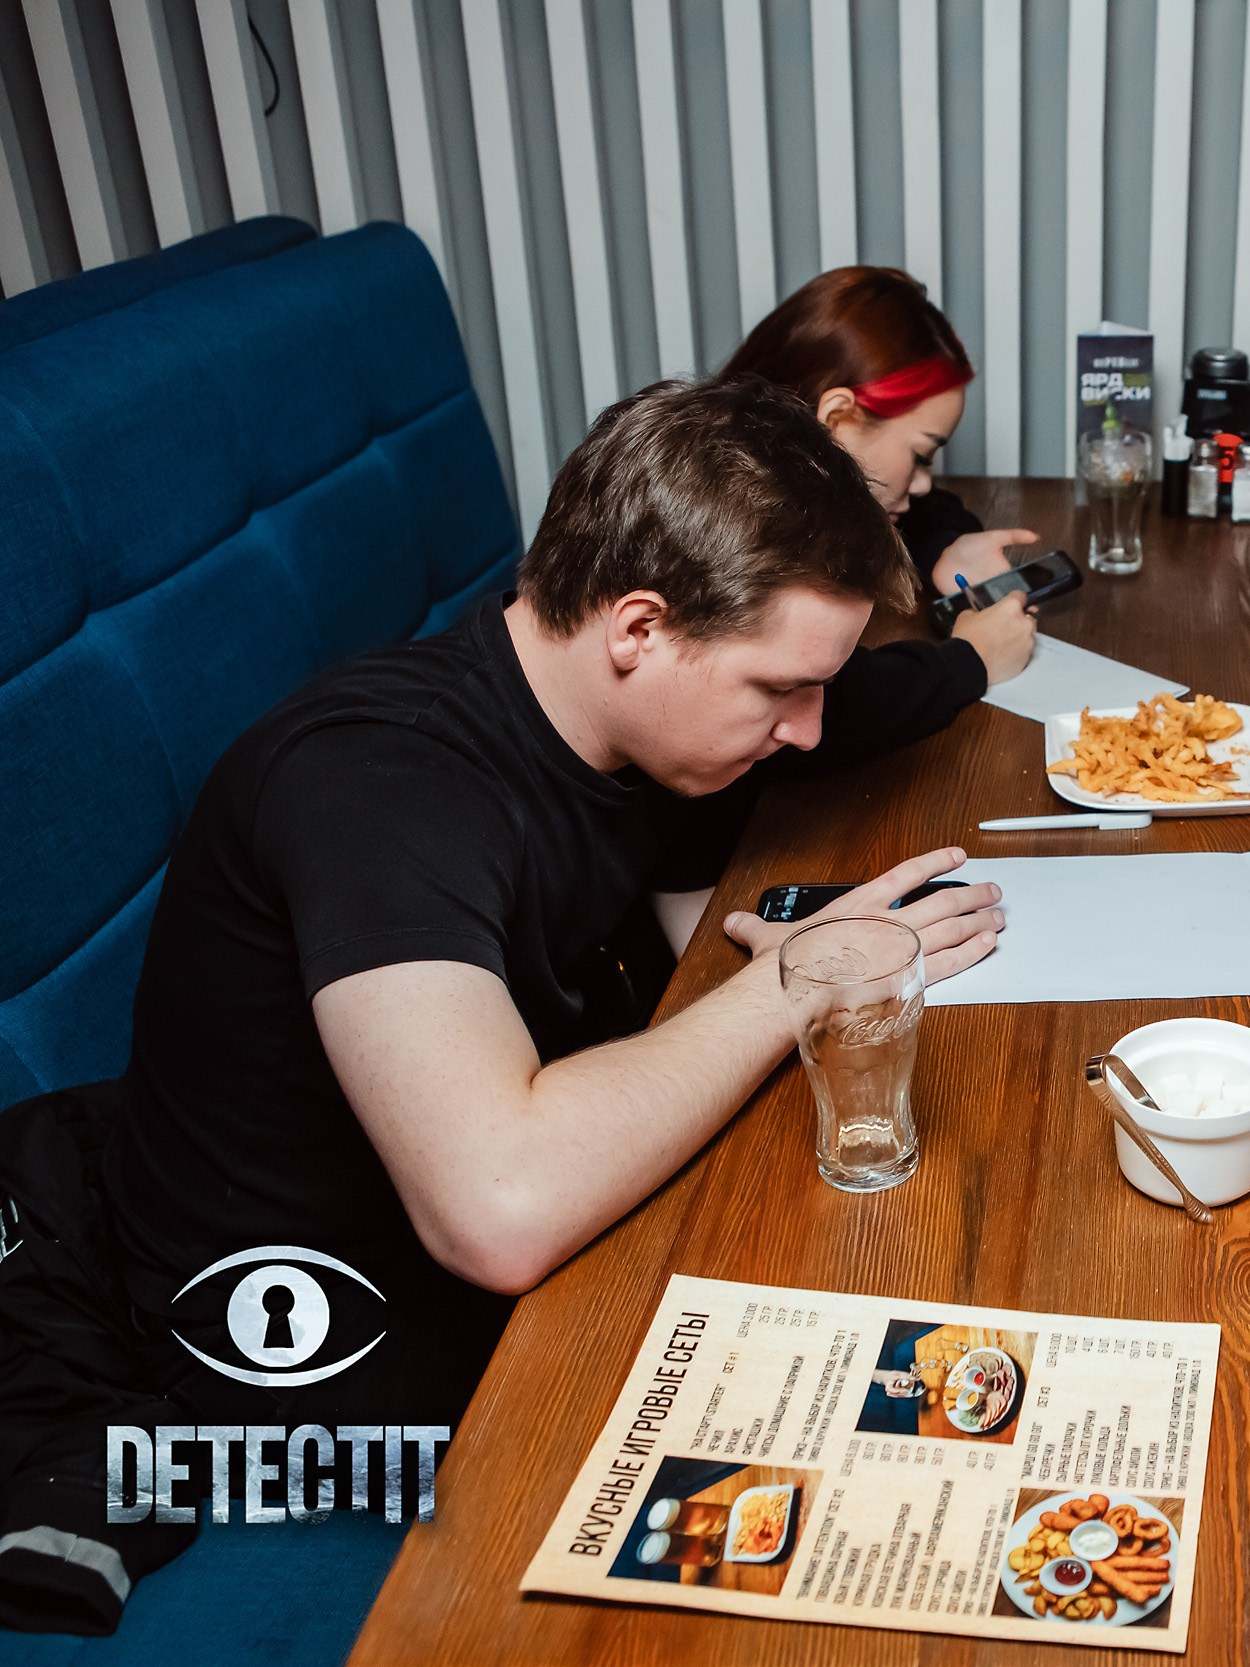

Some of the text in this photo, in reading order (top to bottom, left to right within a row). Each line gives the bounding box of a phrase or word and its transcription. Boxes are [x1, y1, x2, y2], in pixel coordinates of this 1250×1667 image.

[1081, 373, 1124, 387] ЯРД
[569, 1311, 710, 1556] ВКУСНЫЕ ИГРОВЫЕ СЕТЫ
